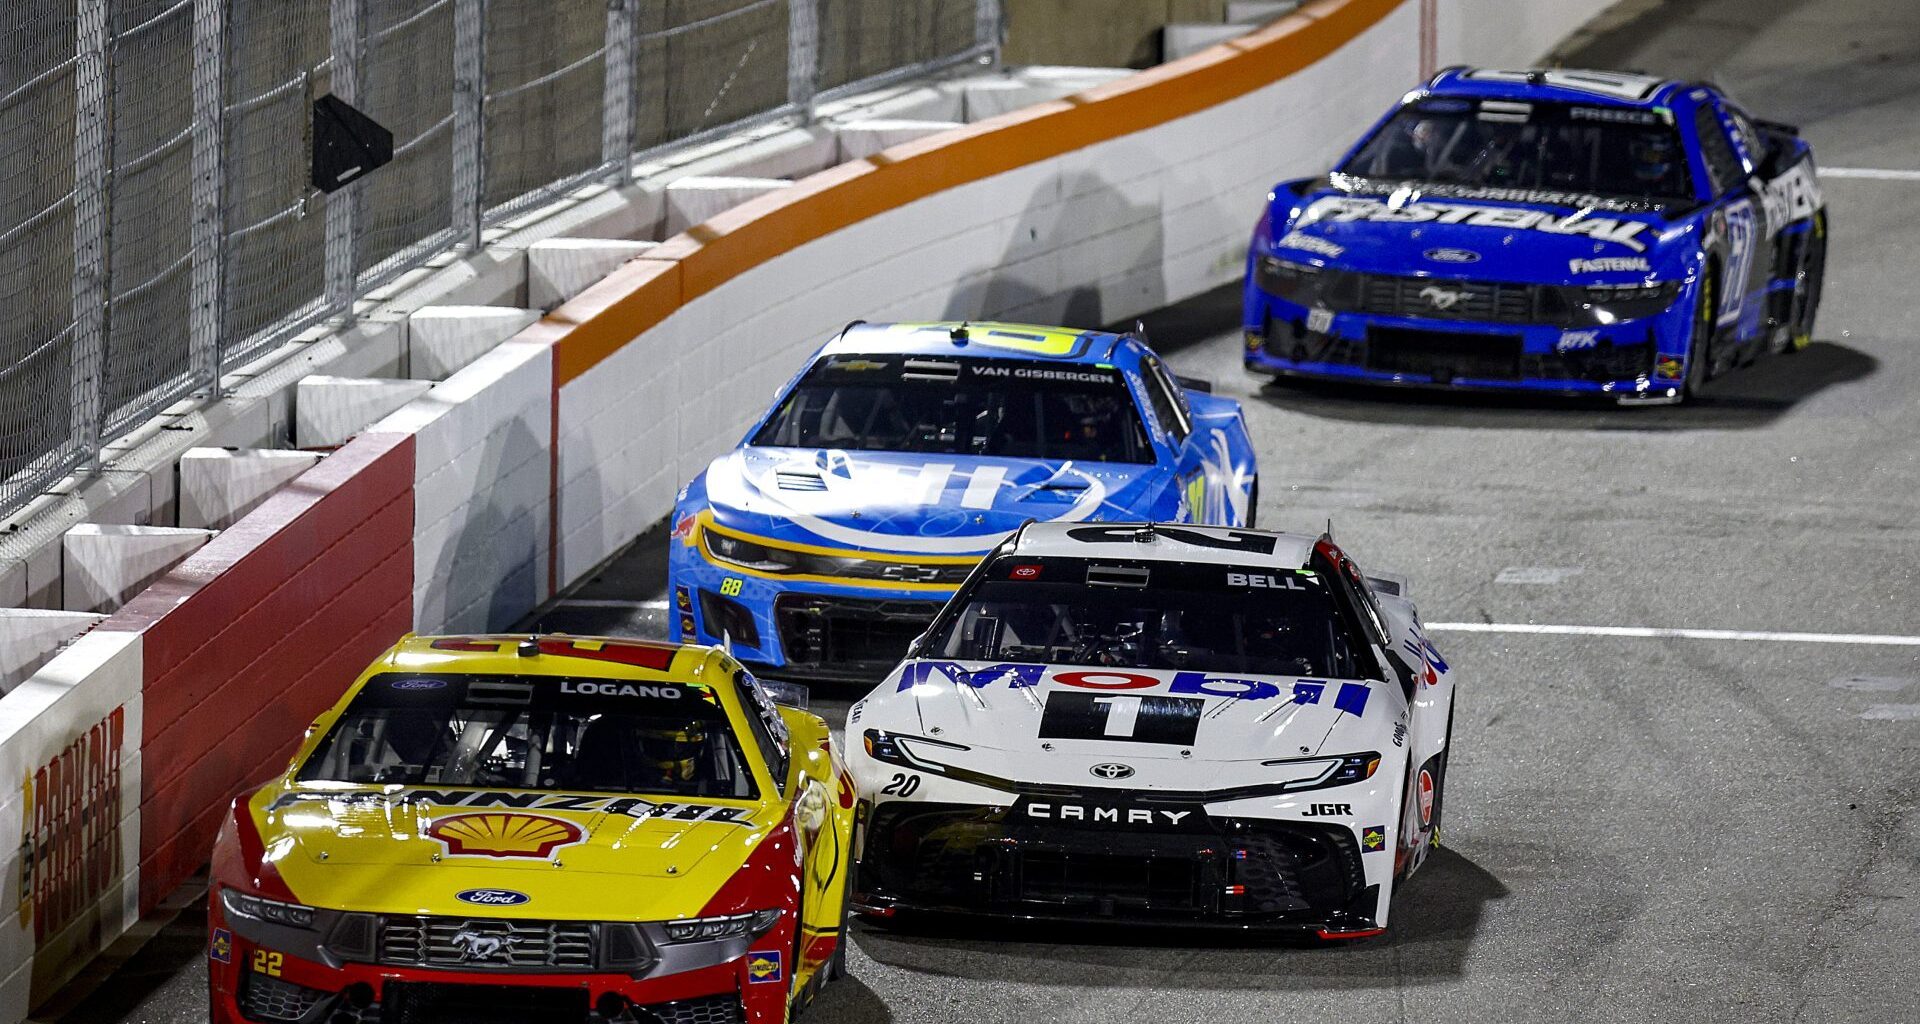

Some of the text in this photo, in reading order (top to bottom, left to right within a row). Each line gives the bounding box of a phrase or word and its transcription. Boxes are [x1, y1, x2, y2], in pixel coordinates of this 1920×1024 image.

[1570, 106, 1656, 125] PREECE
[1293, 195, 1648, 252] FASTENAL
[1569, 257, 1650, 276] FASTENAL
[972, 366, 1115, 383] VAN GISBERGEN
[719, 577, 743, 597] 88
[1227, 573, 1306, 591] BELL
[560, 682, 682, 699] LOGANO
[896, 661, 1371, 718] Mobil
[1093, 696, 1143, 737] 1
[881, 773, 922, 798] 20
[1027, 802, 1193, 825] CAMRY
[1302, 804, 1354, 817] JGR
[470, 890, 516, 904] Ford
[253, 949, 283, 977] 22
